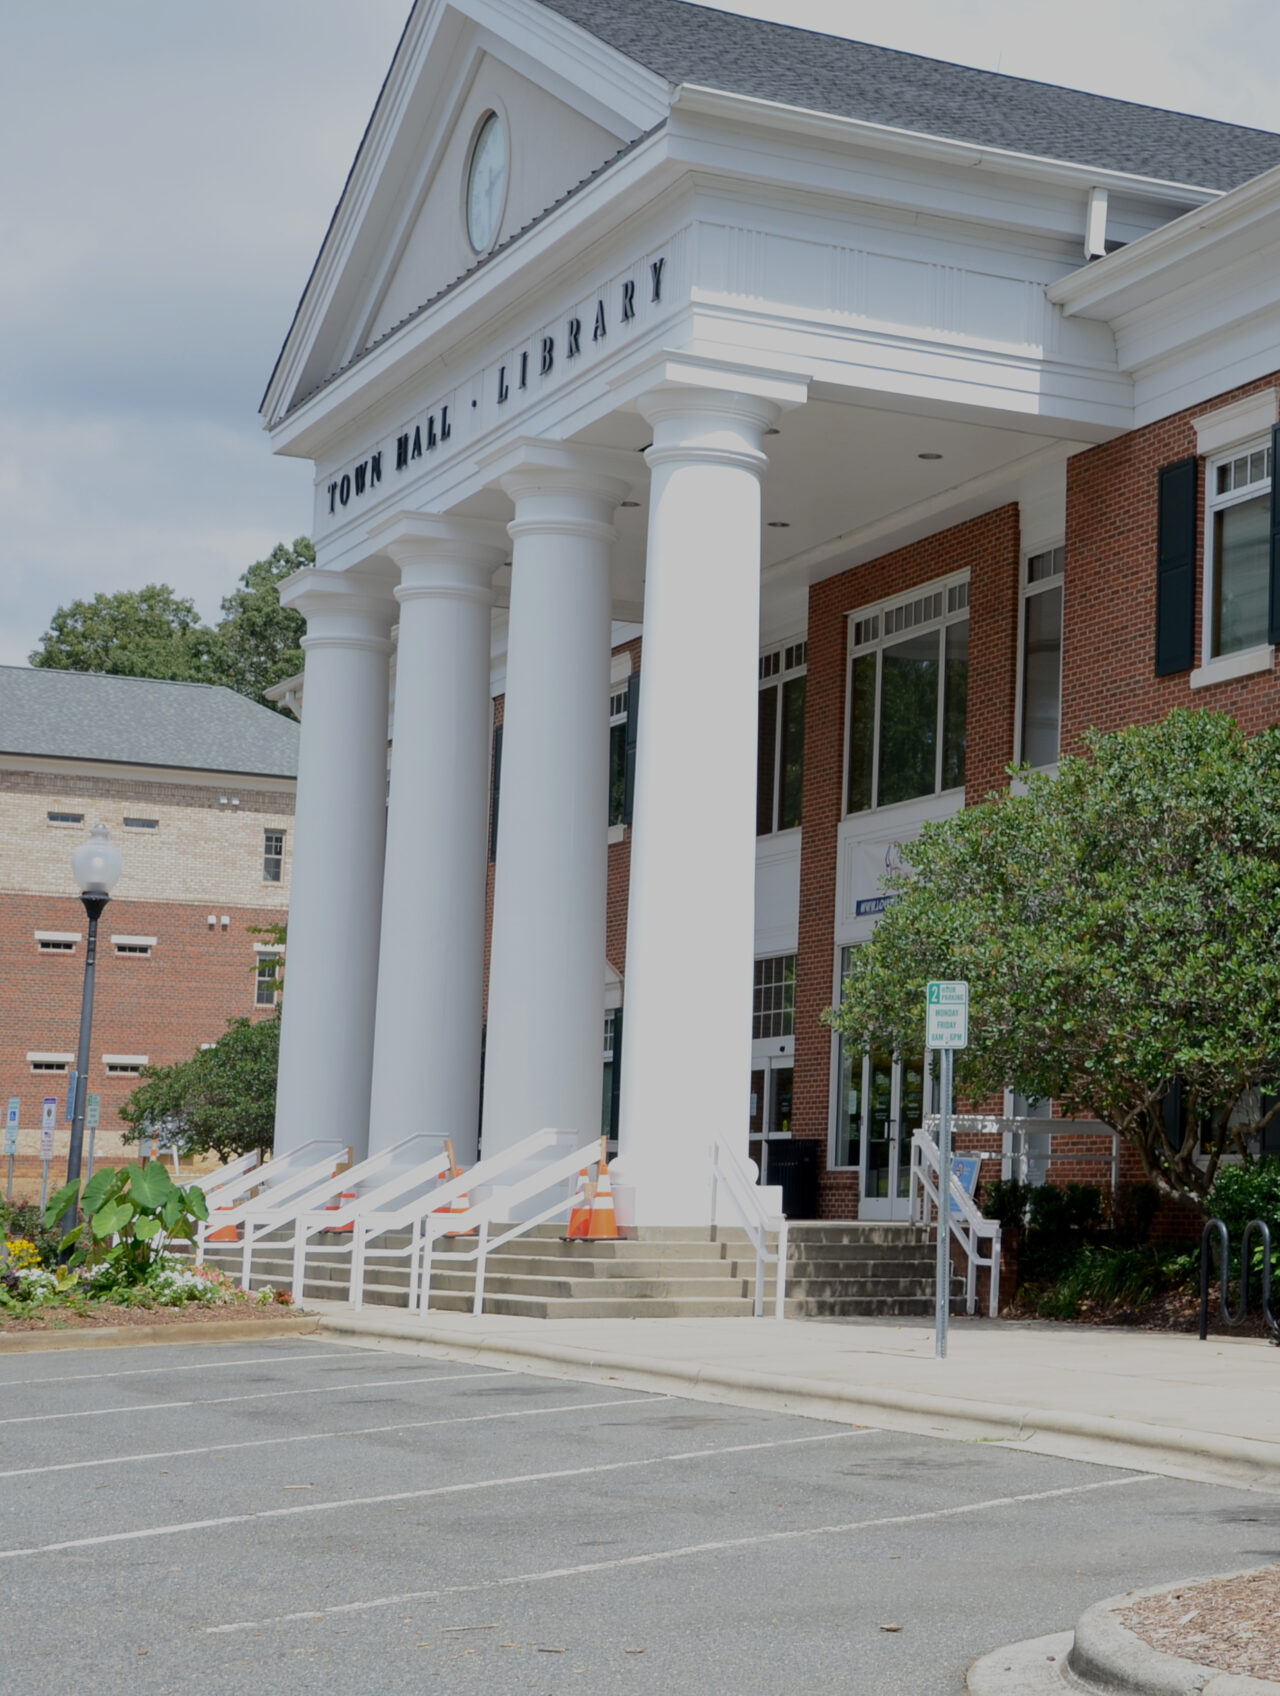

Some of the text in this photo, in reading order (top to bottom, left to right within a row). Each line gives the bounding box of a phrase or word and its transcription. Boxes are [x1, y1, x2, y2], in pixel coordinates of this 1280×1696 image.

[327, 257, 665, 514] TOWN HALL LIBRARY
[931, 986, 938, 1002] 2
[937, 1021, 956, 1029] FRIDAY
